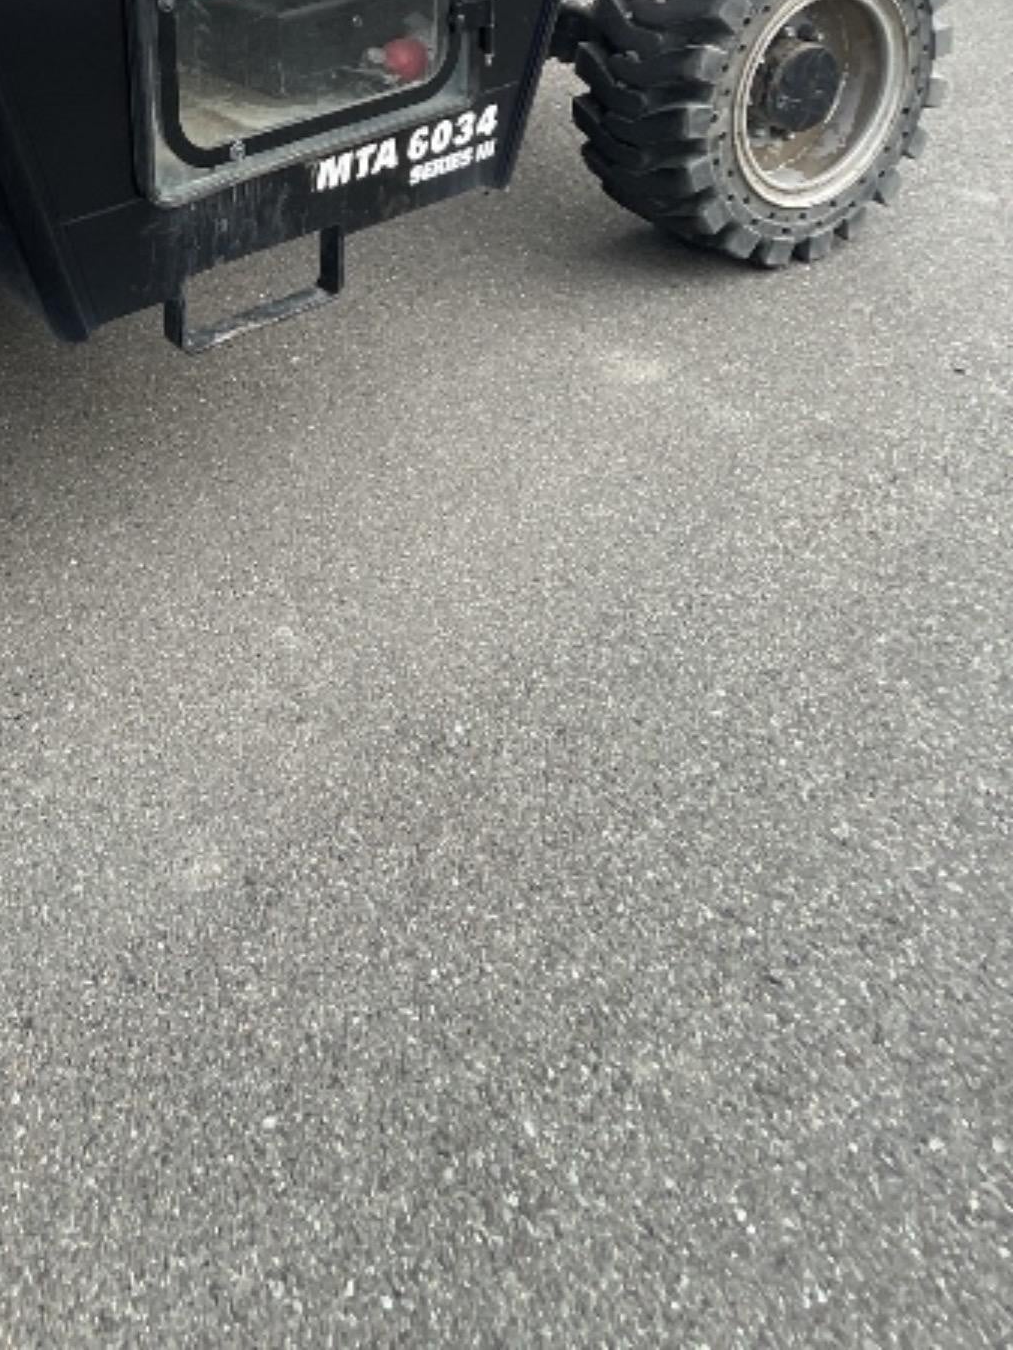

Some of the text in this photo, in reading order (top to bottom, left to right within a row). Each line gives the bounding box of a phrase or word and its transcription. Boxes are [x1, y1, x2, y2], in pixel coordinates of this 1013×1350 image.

[316, 103, 498, 193] MTA 6034
[409, 146, 474, 186] SERIES
